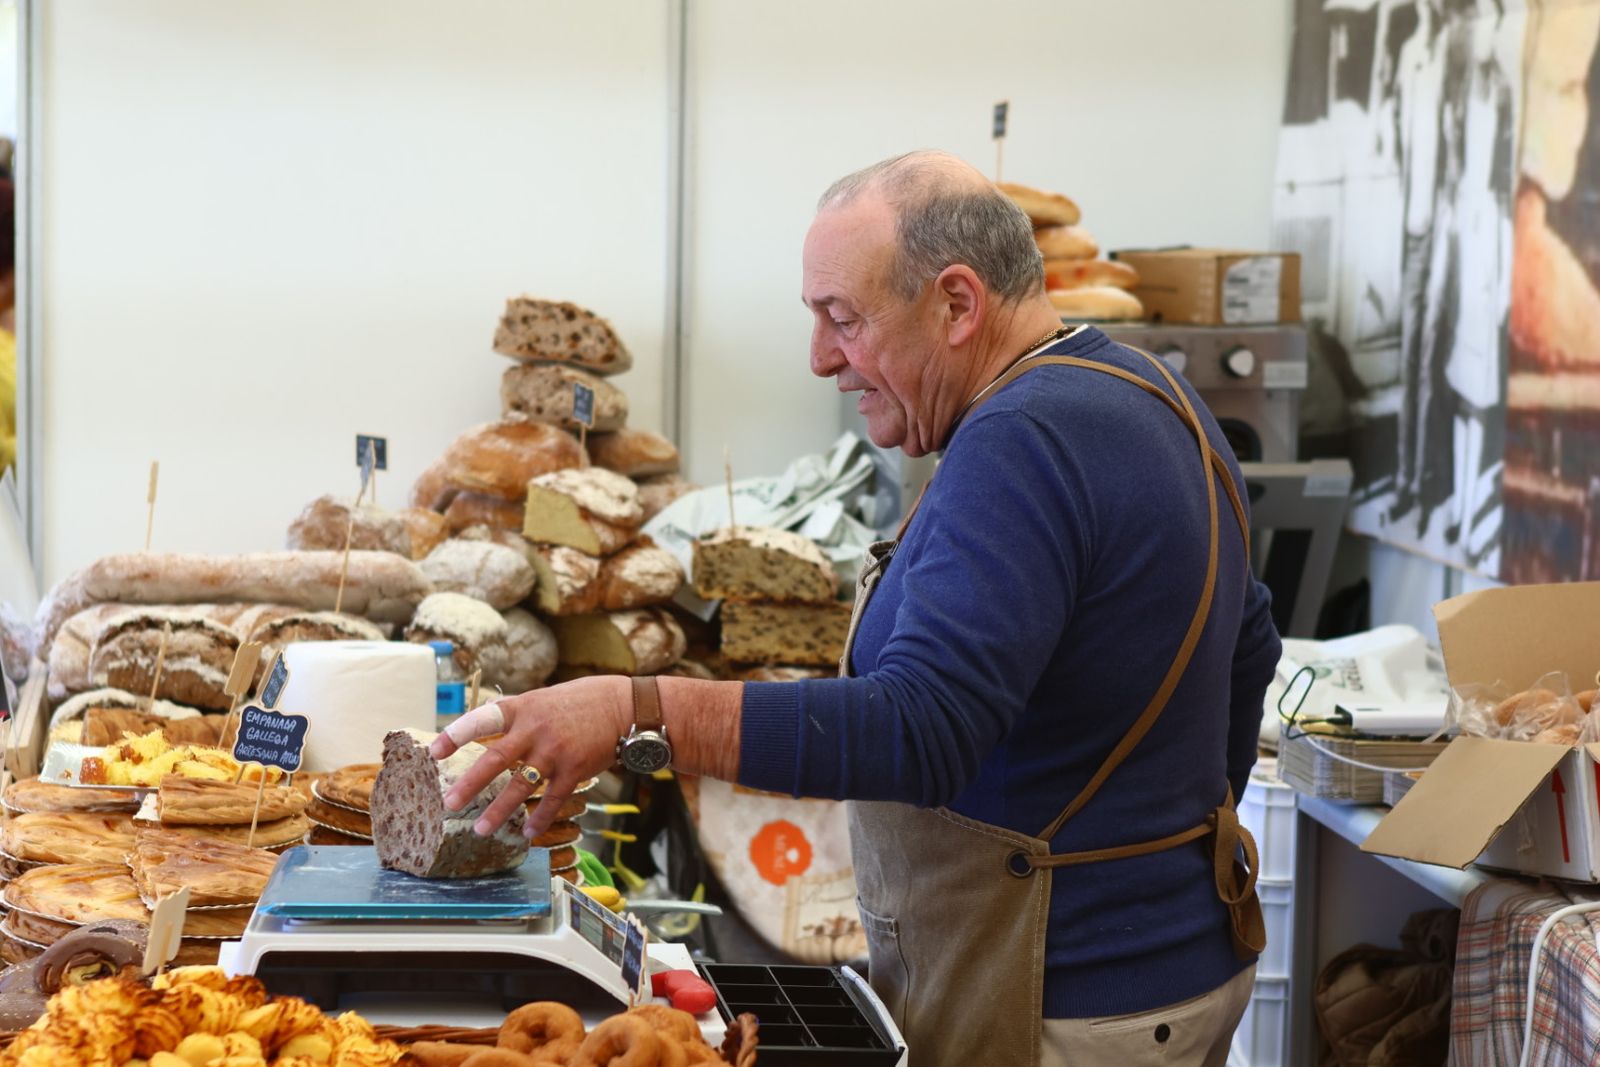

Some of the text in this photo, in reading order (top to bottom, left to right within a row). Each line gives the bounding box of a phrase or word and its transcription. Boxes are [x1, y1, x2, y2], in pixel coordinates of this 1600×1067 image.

[245, 711, 297, 733] EMPANADA
[246, 727, 289, 746] GALLEGA
[236, 742, 279, 760] ARTESANA
